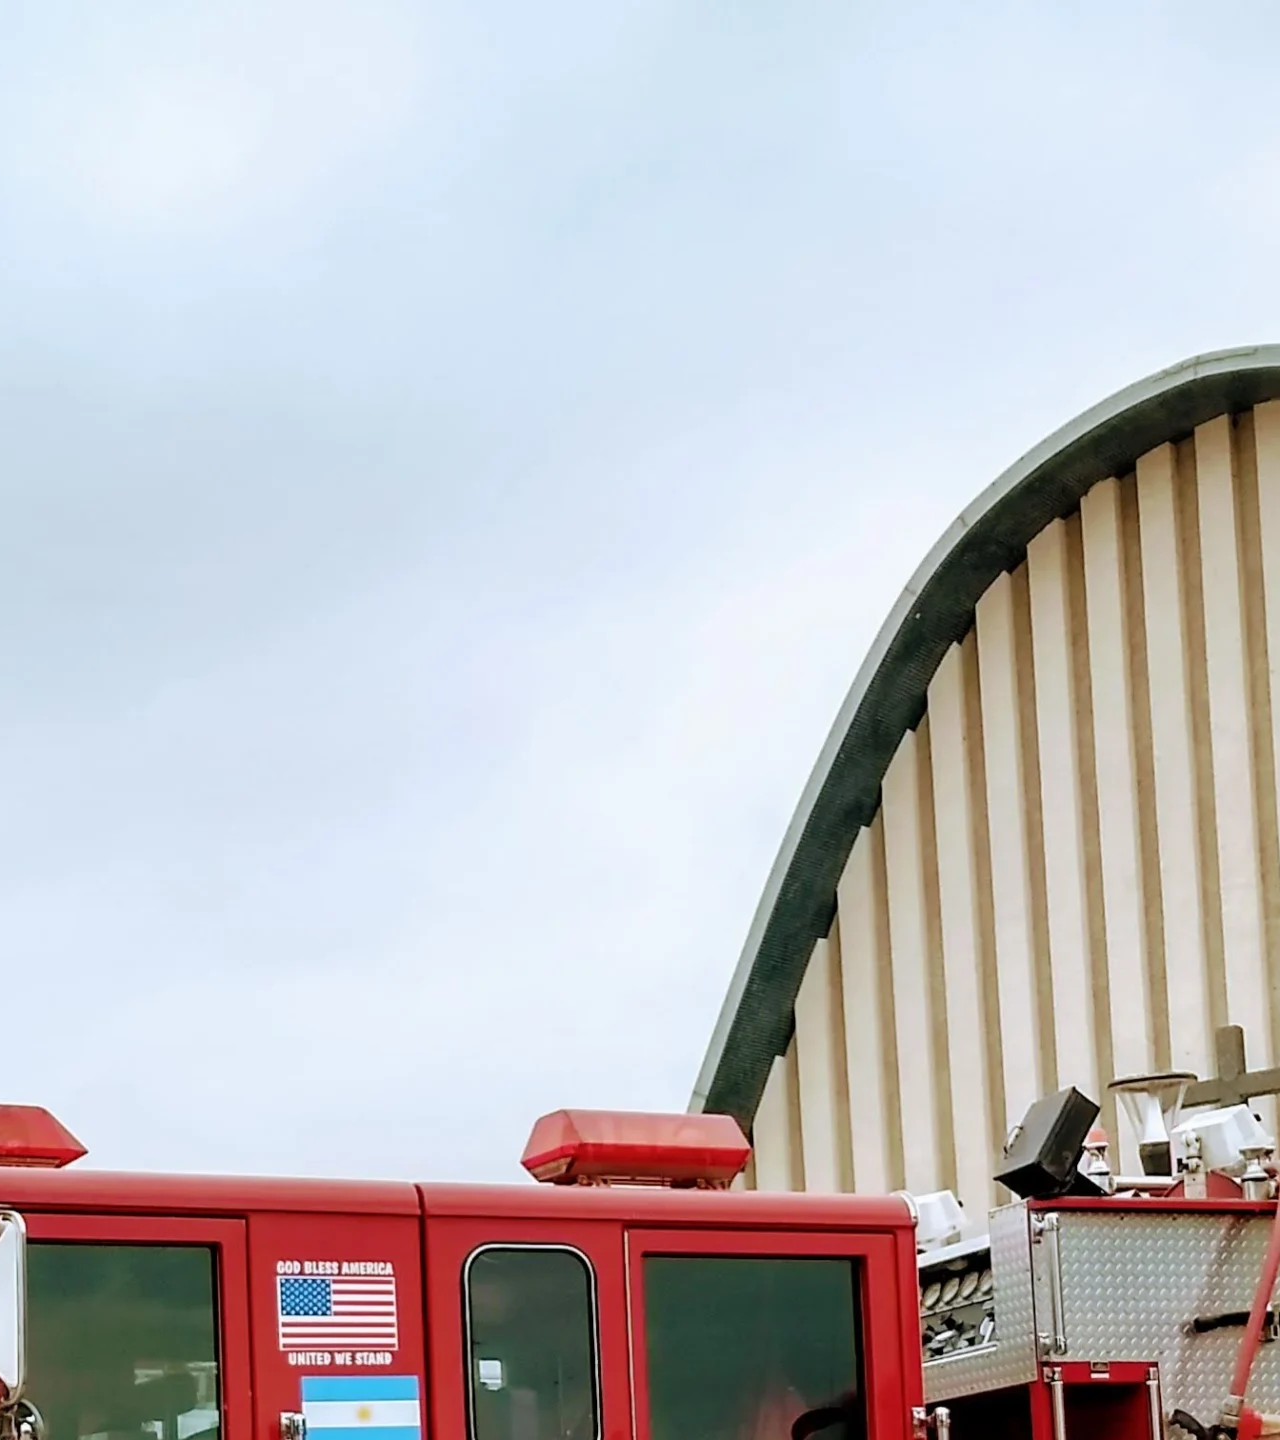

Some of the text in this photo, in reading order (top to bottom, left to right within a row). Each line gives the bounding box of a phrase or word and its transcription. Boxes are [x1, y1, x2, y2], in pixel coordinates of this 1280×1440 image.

[277, 1261, 394, 1275] GOD BLESS AMERICA
[288, 1352, 393, 1365] UNITED WE STAND
